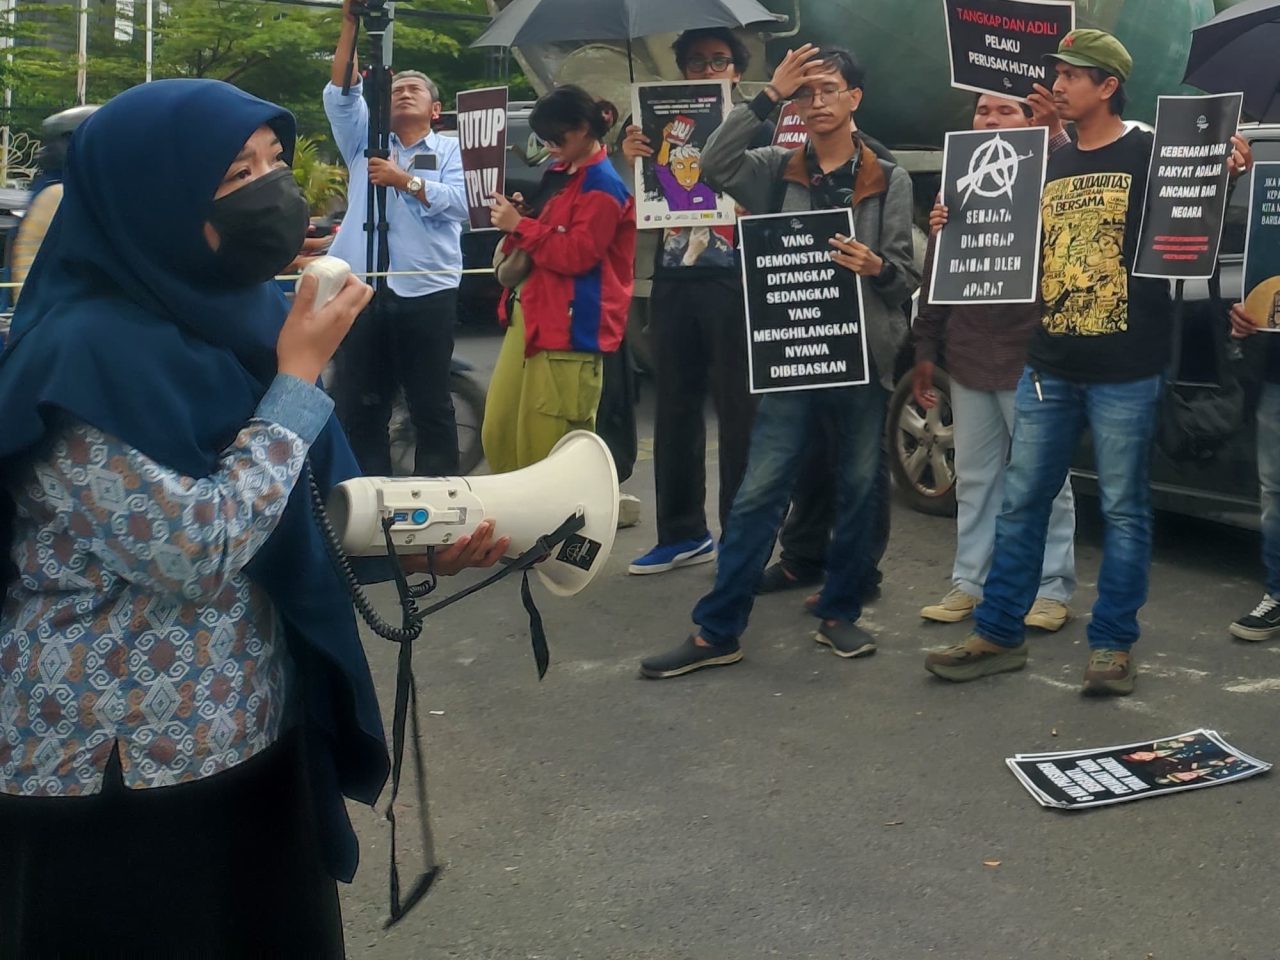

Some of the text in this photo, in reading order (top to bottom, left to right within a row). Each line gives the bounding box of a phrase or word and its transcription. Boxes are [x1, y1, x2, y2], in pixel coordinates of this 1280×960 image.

[956, 8, 1057, 35] TANGKAP DAN ADILI
[985, 34, 1020, 53] PELAKU
[969, 51, 1045, 79] PERUSAK HUTAN
[459, 108, 505, 150] TUTUP
[777, 132, 807, 143] BUKAN
[1160, 143, 1227, 158] KEBENARAN DARI
[1158, 163, 1221, 178] RAKYAT ADALAH
[1071, 175, 1130, 192] SOLIDARITAS
[1264, 177, 1276, 187] JIKA
[1159, 185, 1217, 198] ANCAMAN BAGI
[1056, 195, 1104, 212] BERSAMA
[1262, 203, 1275, 212] KITA
[966, 208, 1012, 224] SENJATA
[1171, 206, 1202, 218] NEGARA
[782, 234, 814, 247] YANG
[961, 233, 1014, 249] DIANGGAP
[756, 251, 841, 268] DEMONSTRA
[950, 256, 1021, 273] MAINAN OLEH
[767, 269, 835, 286] DITANGKAP
[766, 287, 840, 304] SEDANGKAN
[963, 281, 1004, 297] APARAT
[788, 307, 821, 320] YANG
[753, 322, 858, 342] MENGHILANGKAN
[785, 343, 829, 358] NYAWA
[770, 360, 846, 378] DIBEBASKAN
